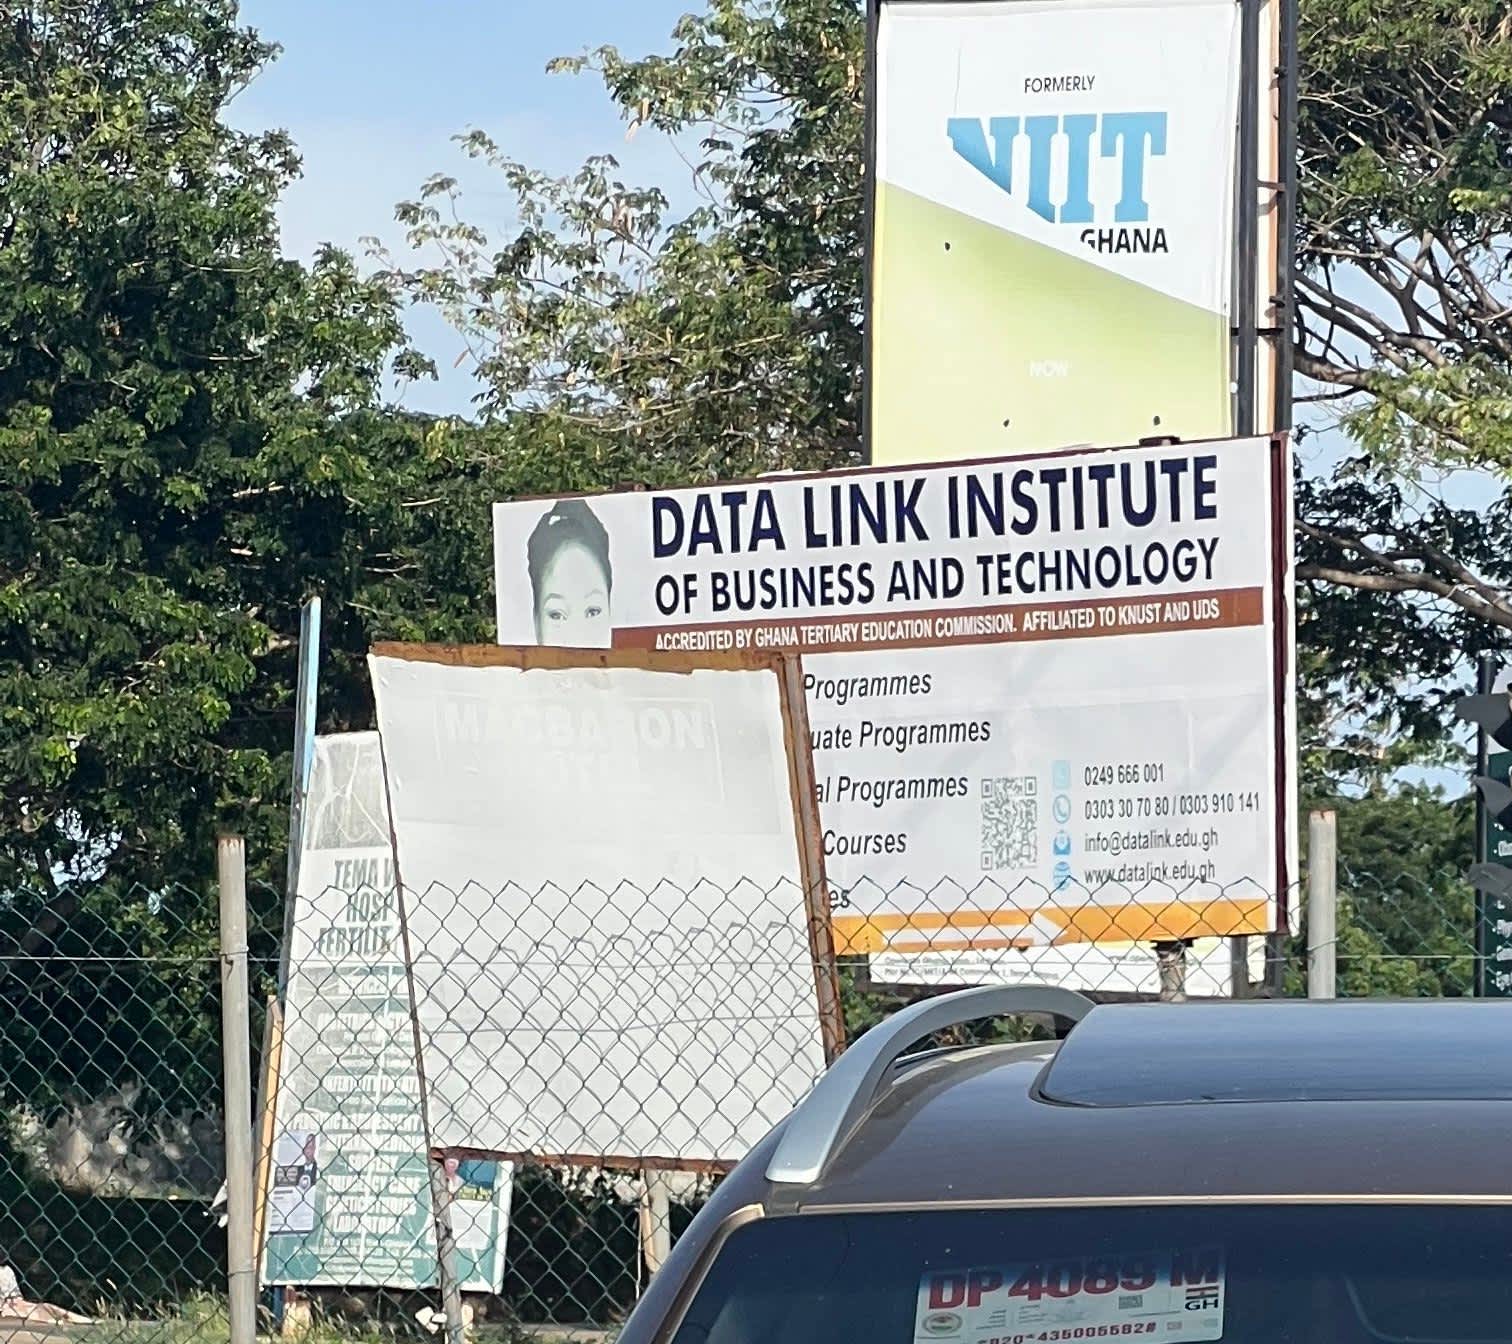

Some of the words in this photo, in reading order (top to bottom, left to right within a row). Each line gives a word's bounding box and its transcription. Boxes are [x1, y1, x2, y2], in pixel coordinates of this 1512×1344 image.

[1024, 75, 1096, 94] FORMERLY
[1080, 227, 1169, 254] GHANA
[652, 488, 786, 558] DATA
[804, 477, 929, 549] LINK
[948, 454, 1218, 539] INSTITUTE
[656, 570, 698, 616] OF
[711, 562, 875, 612] BUSINESS
[887, 557, 964, 601] AND
[977, 536, 1219, 596] TECHNOLOGY
[655, 629, 733, 651] ACCREDITED
[736, 627, 752, 649] BY
[755, 626, 799, 648] GHANA
[800, 623, 860, 645] TERTIARY
[862, 618, 933, 642] EDUCATION
[935, 613, 1017, 638] COMMISSION.
[1022, 607, 1095, 632] AFFILIATED
[1098, 606, 1115, 628] TO
[1118, 602, 1162, 626] KNUST
[1164, 600, 1191, 622] AND
[1192, 598, 1220, 620] UDS
[803, 672, 932, 706] Programmes
[810, 727, 852, 751] uate
[860, 720, 991, 753] Programmes
[1085, 764, 1114, 786] 0249
[1118, 763, 1139, 785] 666
[1143, 763, 1165, 784] 001
[837, 775, 968, 808] Programmes
[1085, 798, 1115, 820] 0303
[1118, 797, 1133, 818] 30
[1137, 796, 1151, 817] 70
[1180, 793, 1209, 815] 0303
[1239, 792, 1260, 813] 141
[822, 829, 907, 856] Courses
[1085, 828, 1219, 856] info@datalink.edu.gh
[334, 858, 378, 889] TEMA
[1085, 861, 1216, 884] www.datalink.edu.gh
[346, 892, 395, 922] HOSP
[928, 1268, 1004, 1310] DP
[1184, 1298, 1219, 1312] GH
